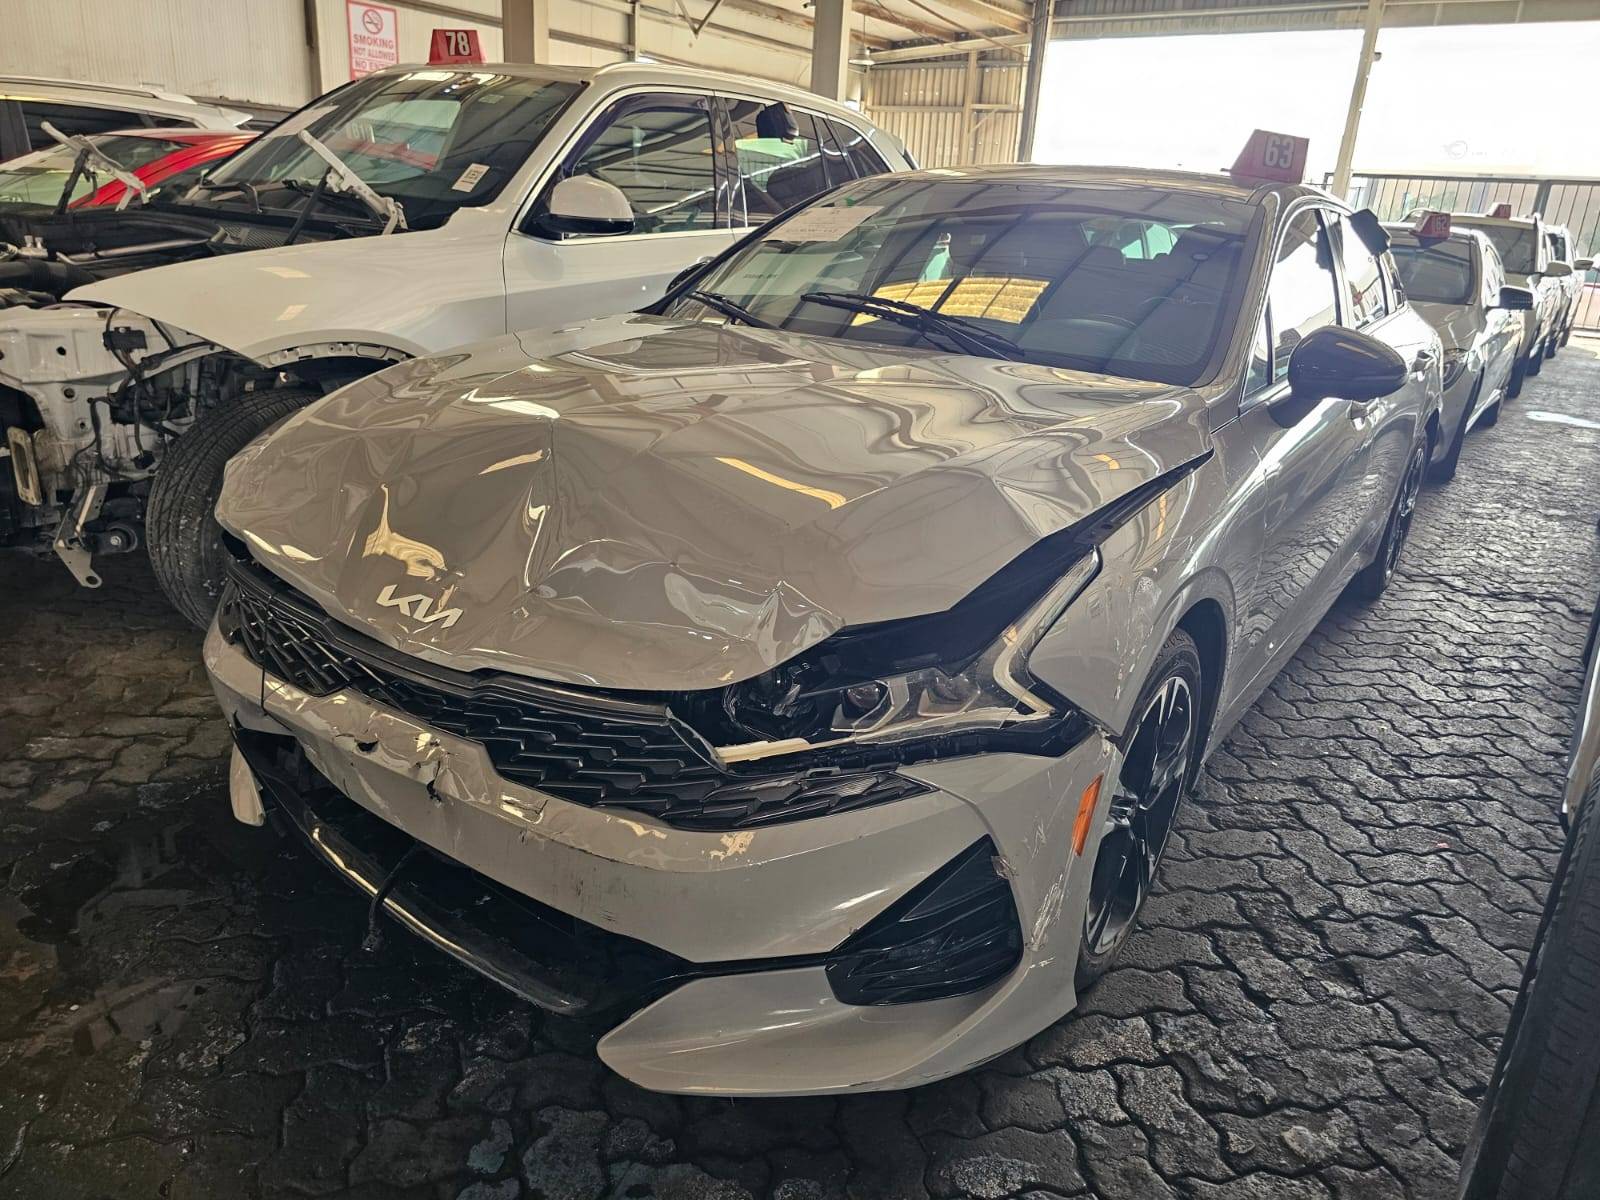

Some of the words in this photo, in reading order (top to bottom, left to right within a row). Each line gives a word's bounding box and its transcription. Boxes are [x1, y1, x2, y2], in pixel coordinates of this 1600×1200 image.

[353, 34, 394, 49] SMOKING
[445, 31, 470, 56] 78
[353, 46, 366, 56] NOT
[355, 60, 368, 69] NO
[1264, 134, 1294, 168] 63
